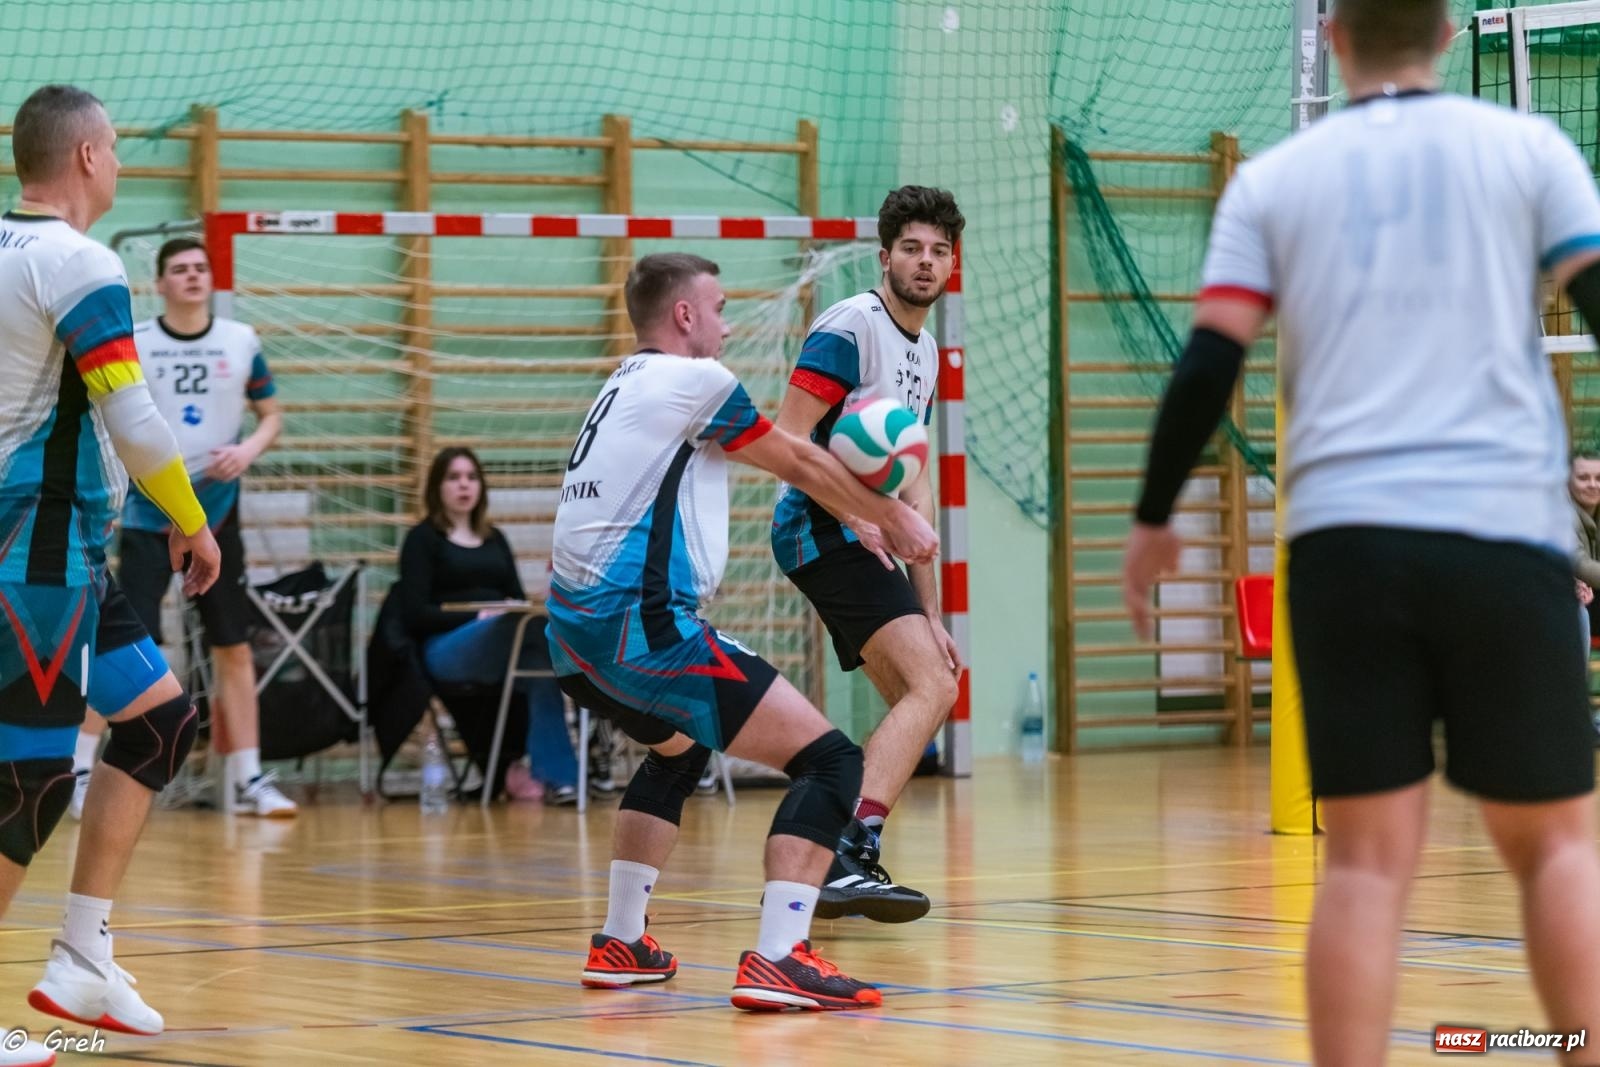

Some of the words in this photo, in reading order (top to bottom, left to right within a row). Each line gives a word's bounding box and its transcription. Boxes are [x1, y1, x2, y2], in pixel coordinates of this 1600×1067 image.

[1482, 16, 1505, 26] netex
[173, 363, 209, 395] 22
[567, 386, 620, 472] 8
